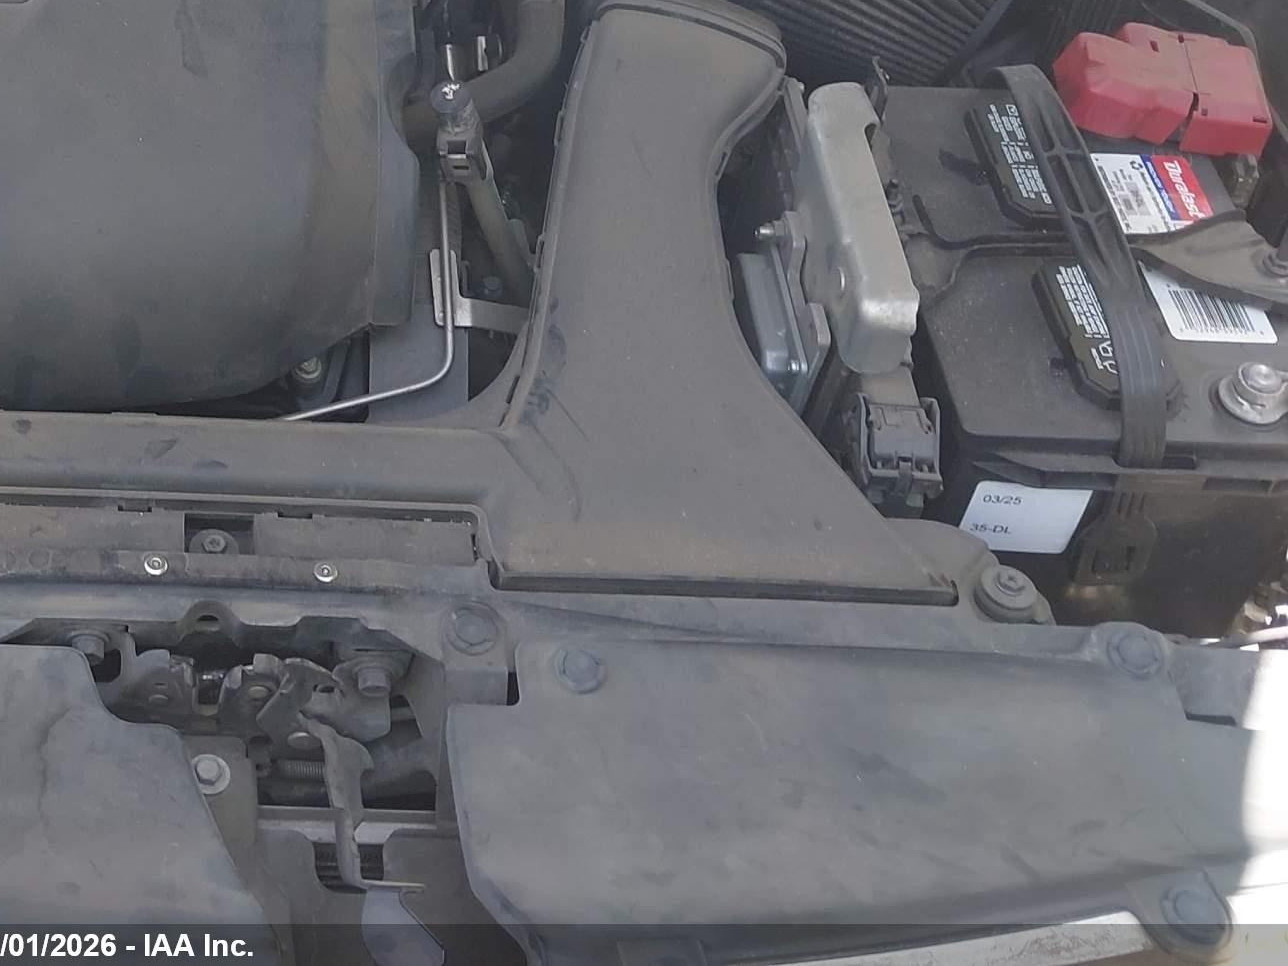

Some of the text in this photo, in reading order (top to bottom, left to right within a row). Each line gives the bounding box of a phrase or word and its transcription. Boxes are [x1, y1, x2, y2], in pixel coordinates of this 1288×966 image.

[1162, 158, 1207, 219] Duralast
[982, 494, 1023, 505] 03/25
[969, 523, 1012, 534] 35-DL
